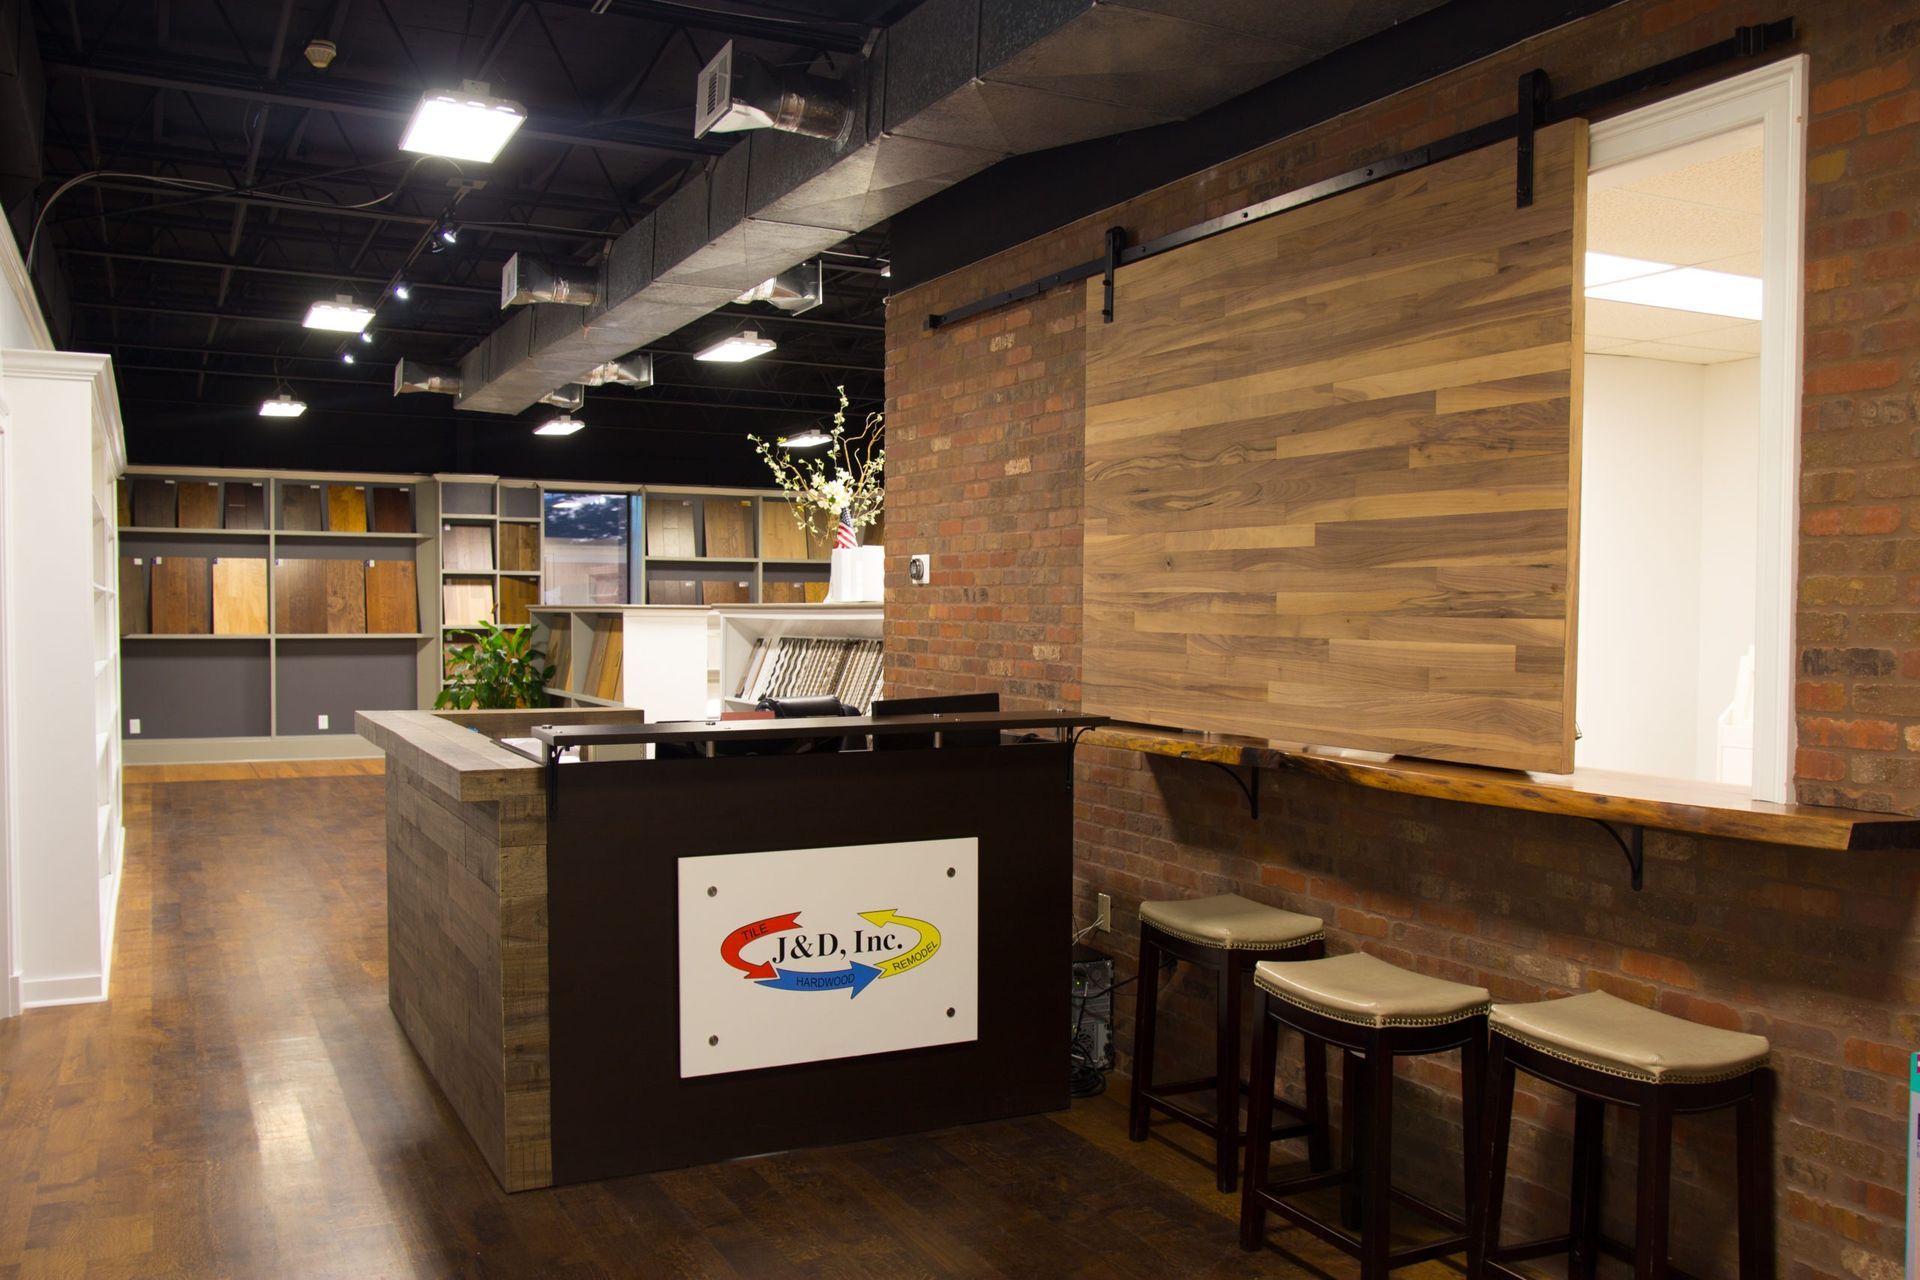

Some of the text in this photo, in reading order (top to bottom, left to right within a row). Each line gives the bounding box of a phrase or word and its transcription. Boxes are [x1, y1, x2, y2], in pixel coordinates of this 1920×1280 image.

[741, 923, 768, 941] TILE
[772, 930, 903, 964] J&D, Inc.
[892, 941, 938, 971] REMODEL
[796, 973, 855, 988] HARDWOOD
